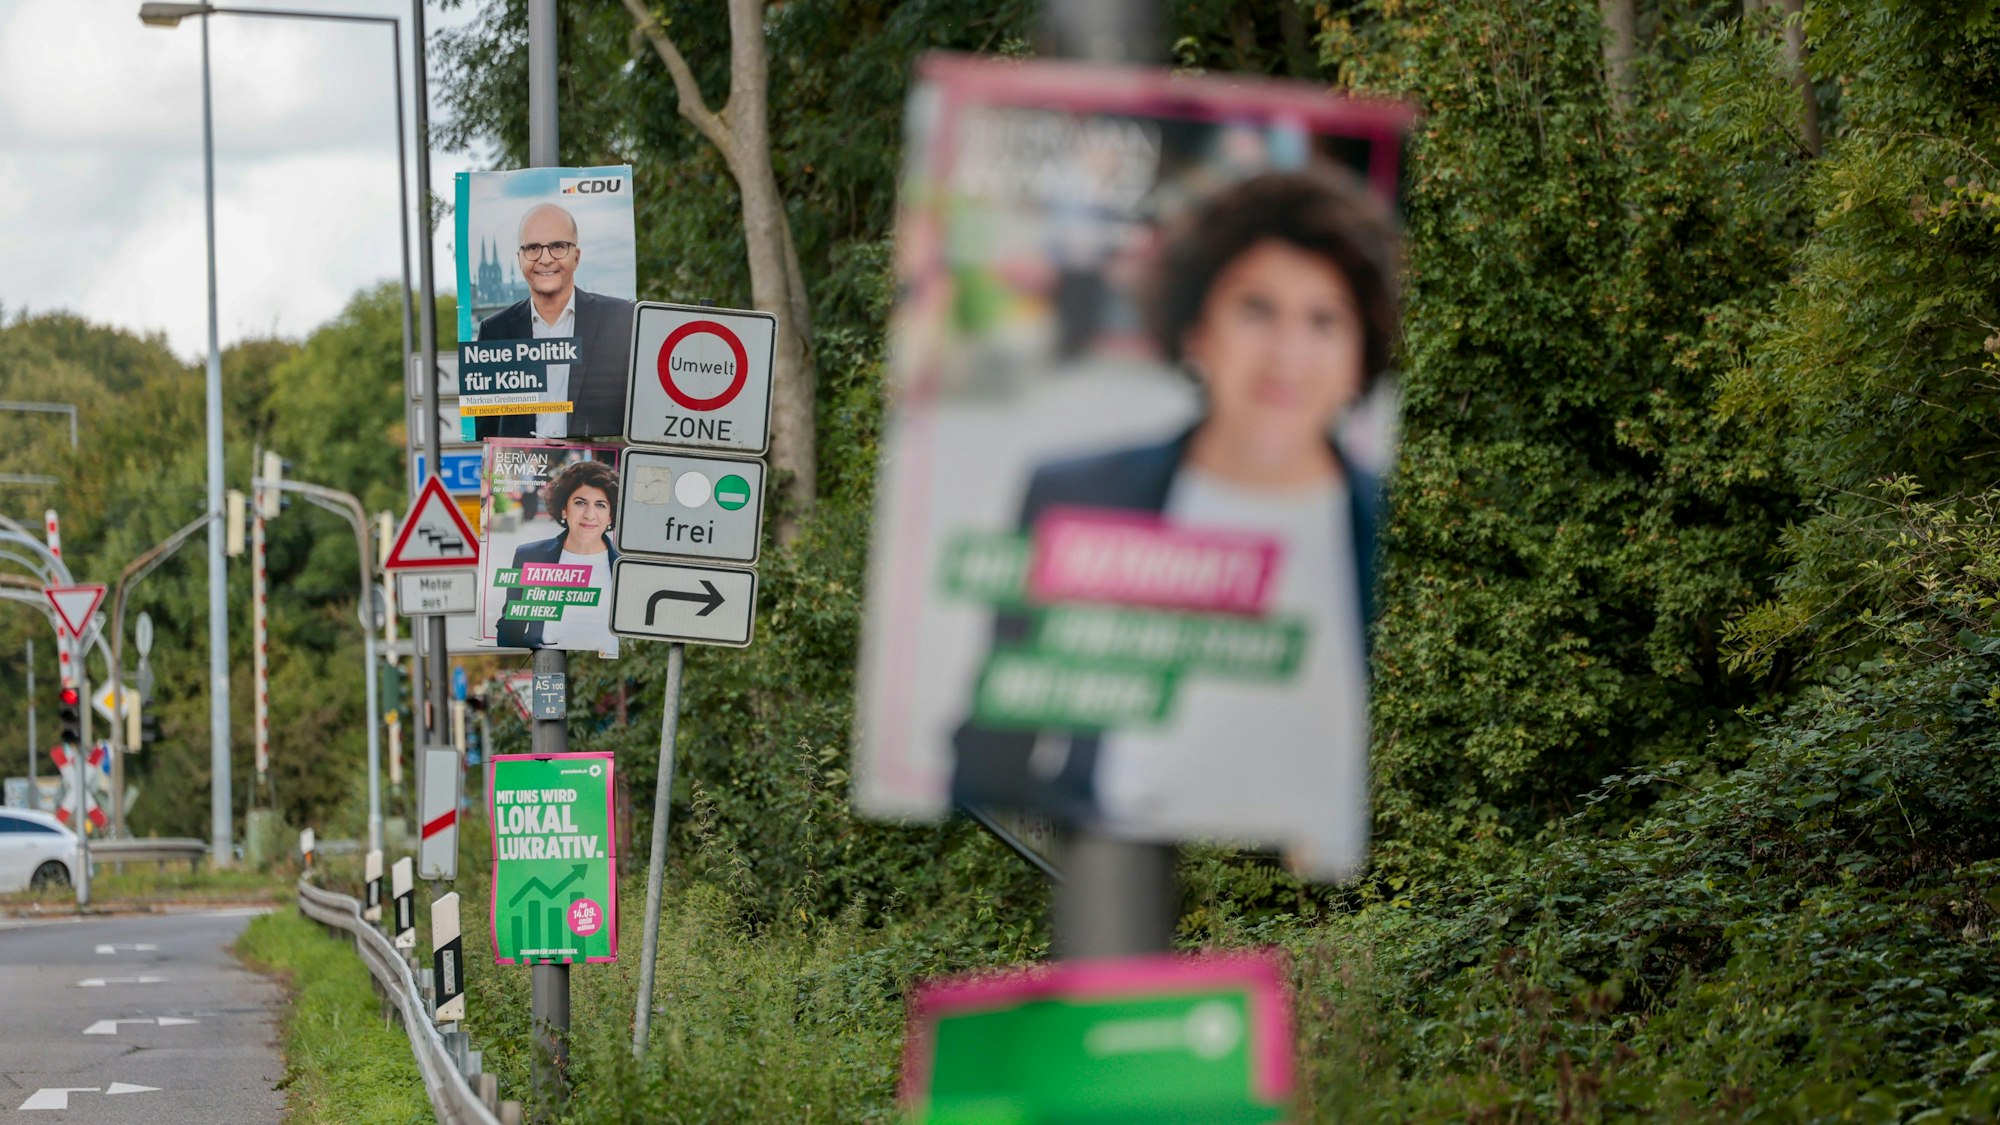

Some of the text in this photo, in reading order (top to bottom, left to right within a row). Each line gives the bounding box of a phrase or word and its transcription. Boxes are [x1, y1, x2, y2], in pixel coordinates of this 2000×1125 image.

[577, 179, 621, 194] CDU
[464, 341, 578, 364] Neue Politik
[671, 356, 735, 376] Umwelt
[464, 370, 543, 391] für Köln.
[466, 396, 493, 404] Markus
[467, 402, 571, 415] Ihr neuer Oberbürgermeister
[663, 415, 732, 441] ZONE
[494, 463, 548, 477] AYMAZ
[665, 516, 714, 544] frei
[498, 567, 586, 584] MIT TATKRAFT.
[420, 578, 452, 590] Motor
[526, 587, 596, 603] FÜR DIE STADT
[510, 604, 558, 618] MIT HERZ.
[536, 680, 550, 691] AS
[496, 788, 577, 804] MIT UNS WIRD
[497, 804, 579, 835] LOKAL
[499, 835, 604, 860] LUKRATIV.
[573, 907, 597, 920] 14.09.
